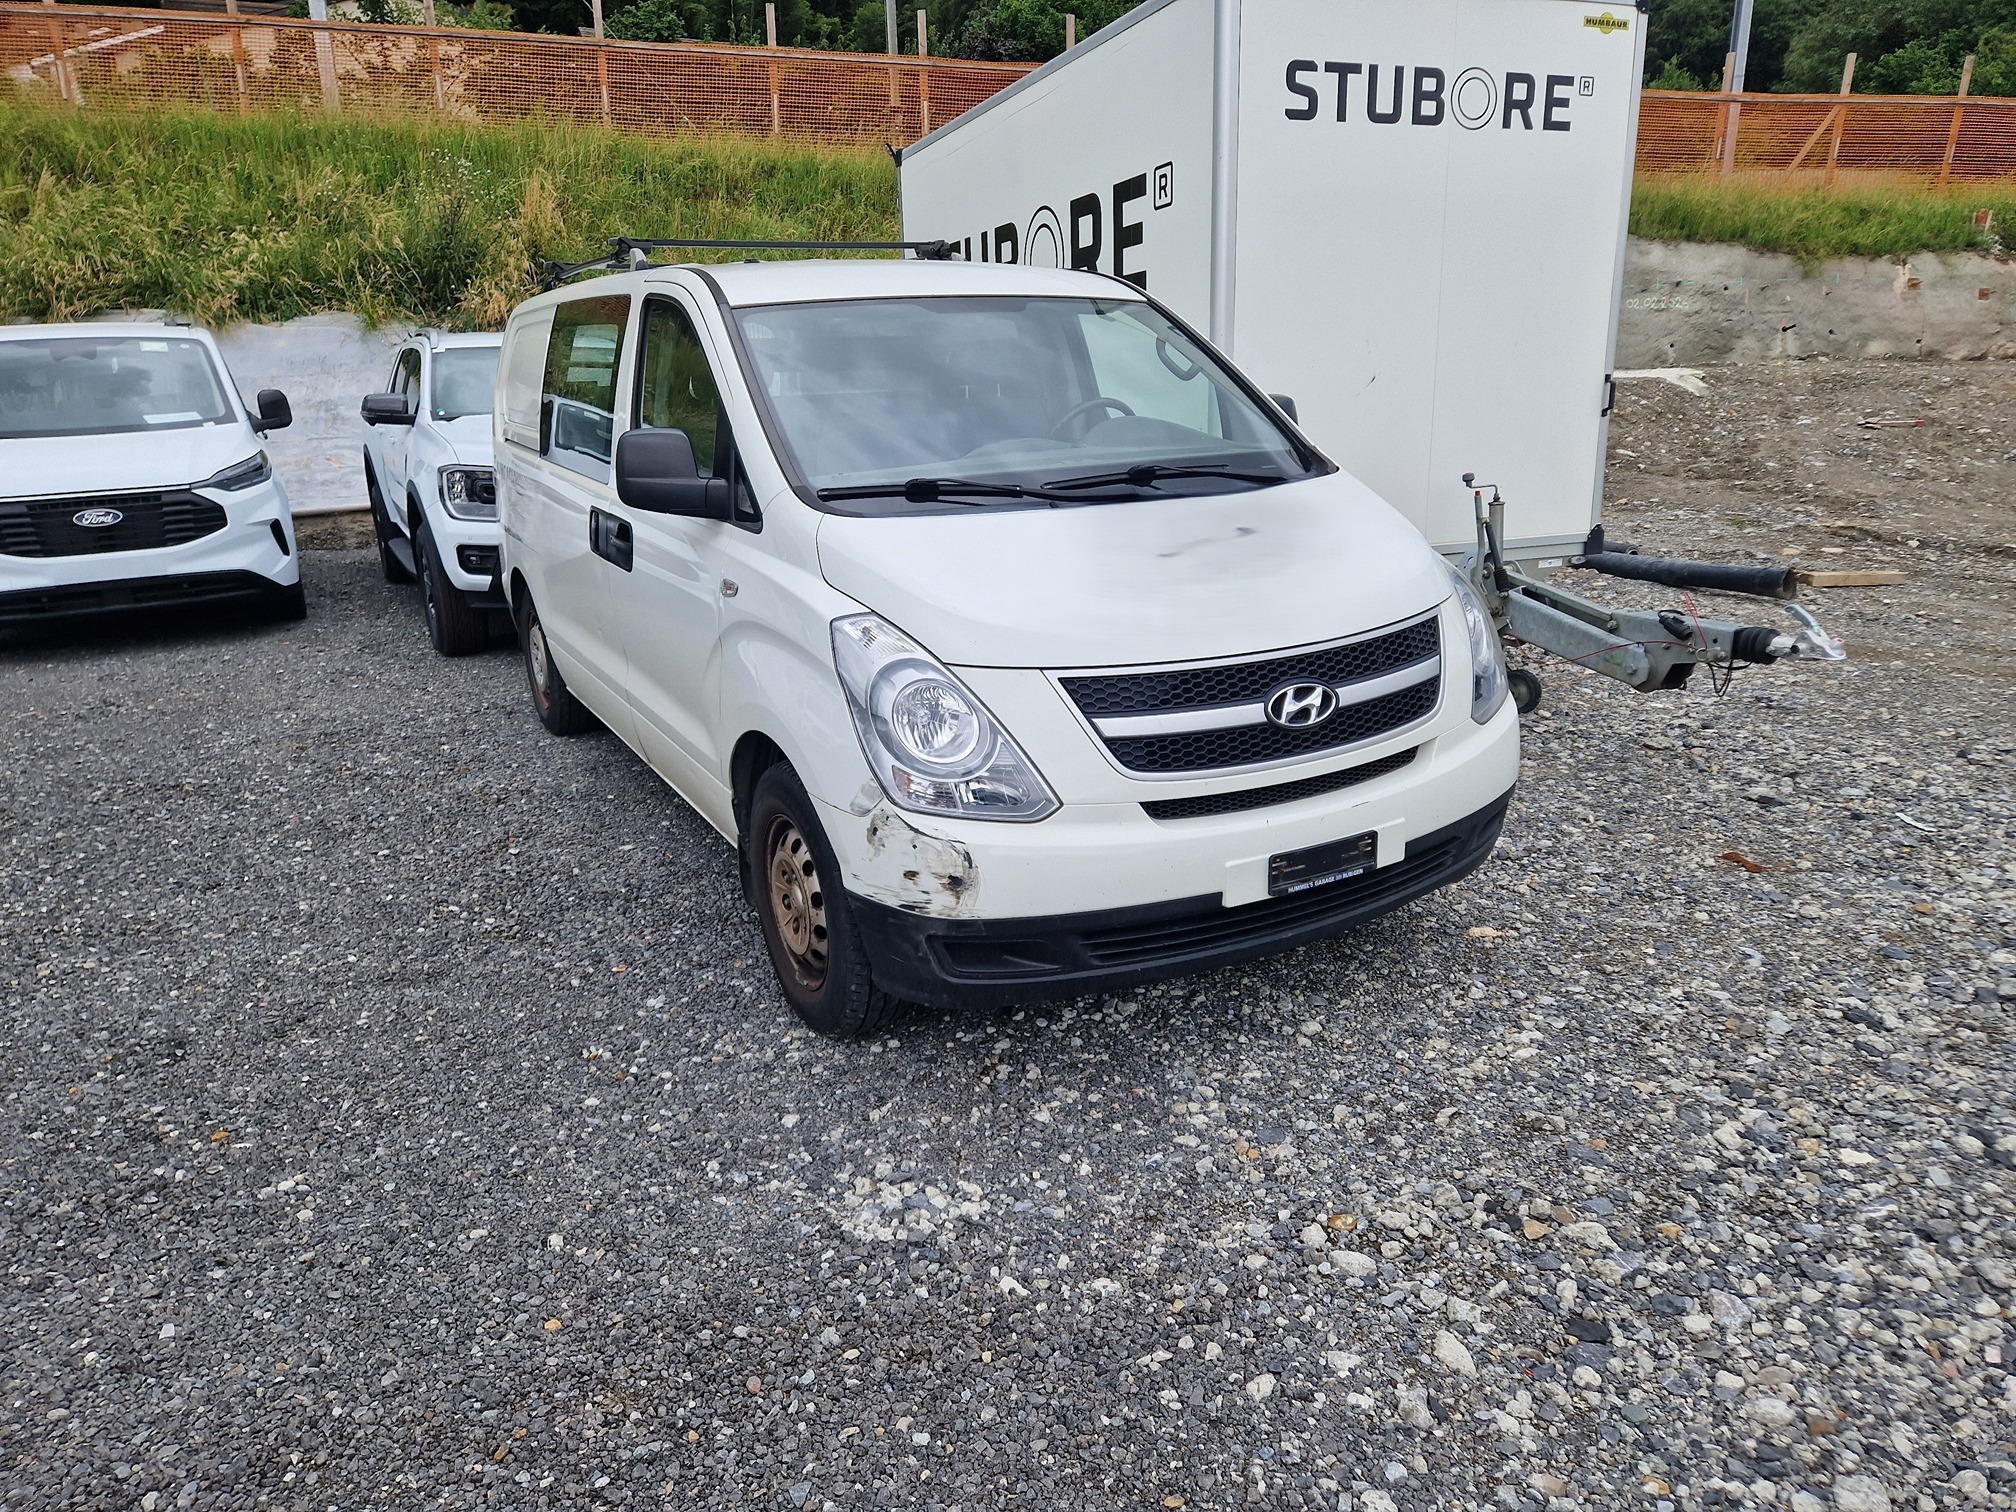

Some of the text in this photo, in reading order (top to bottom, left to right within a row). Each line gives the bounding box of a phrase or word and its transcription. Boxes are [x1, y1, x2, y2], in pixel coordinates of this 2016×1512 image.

[1585, 17, 1628, 29] HUMBAUR
[1285, 59, 1575, 131] STUBORE
[82, 511, 114, 525] Ford
[1314, 876, 1335, 886] GARAGE
